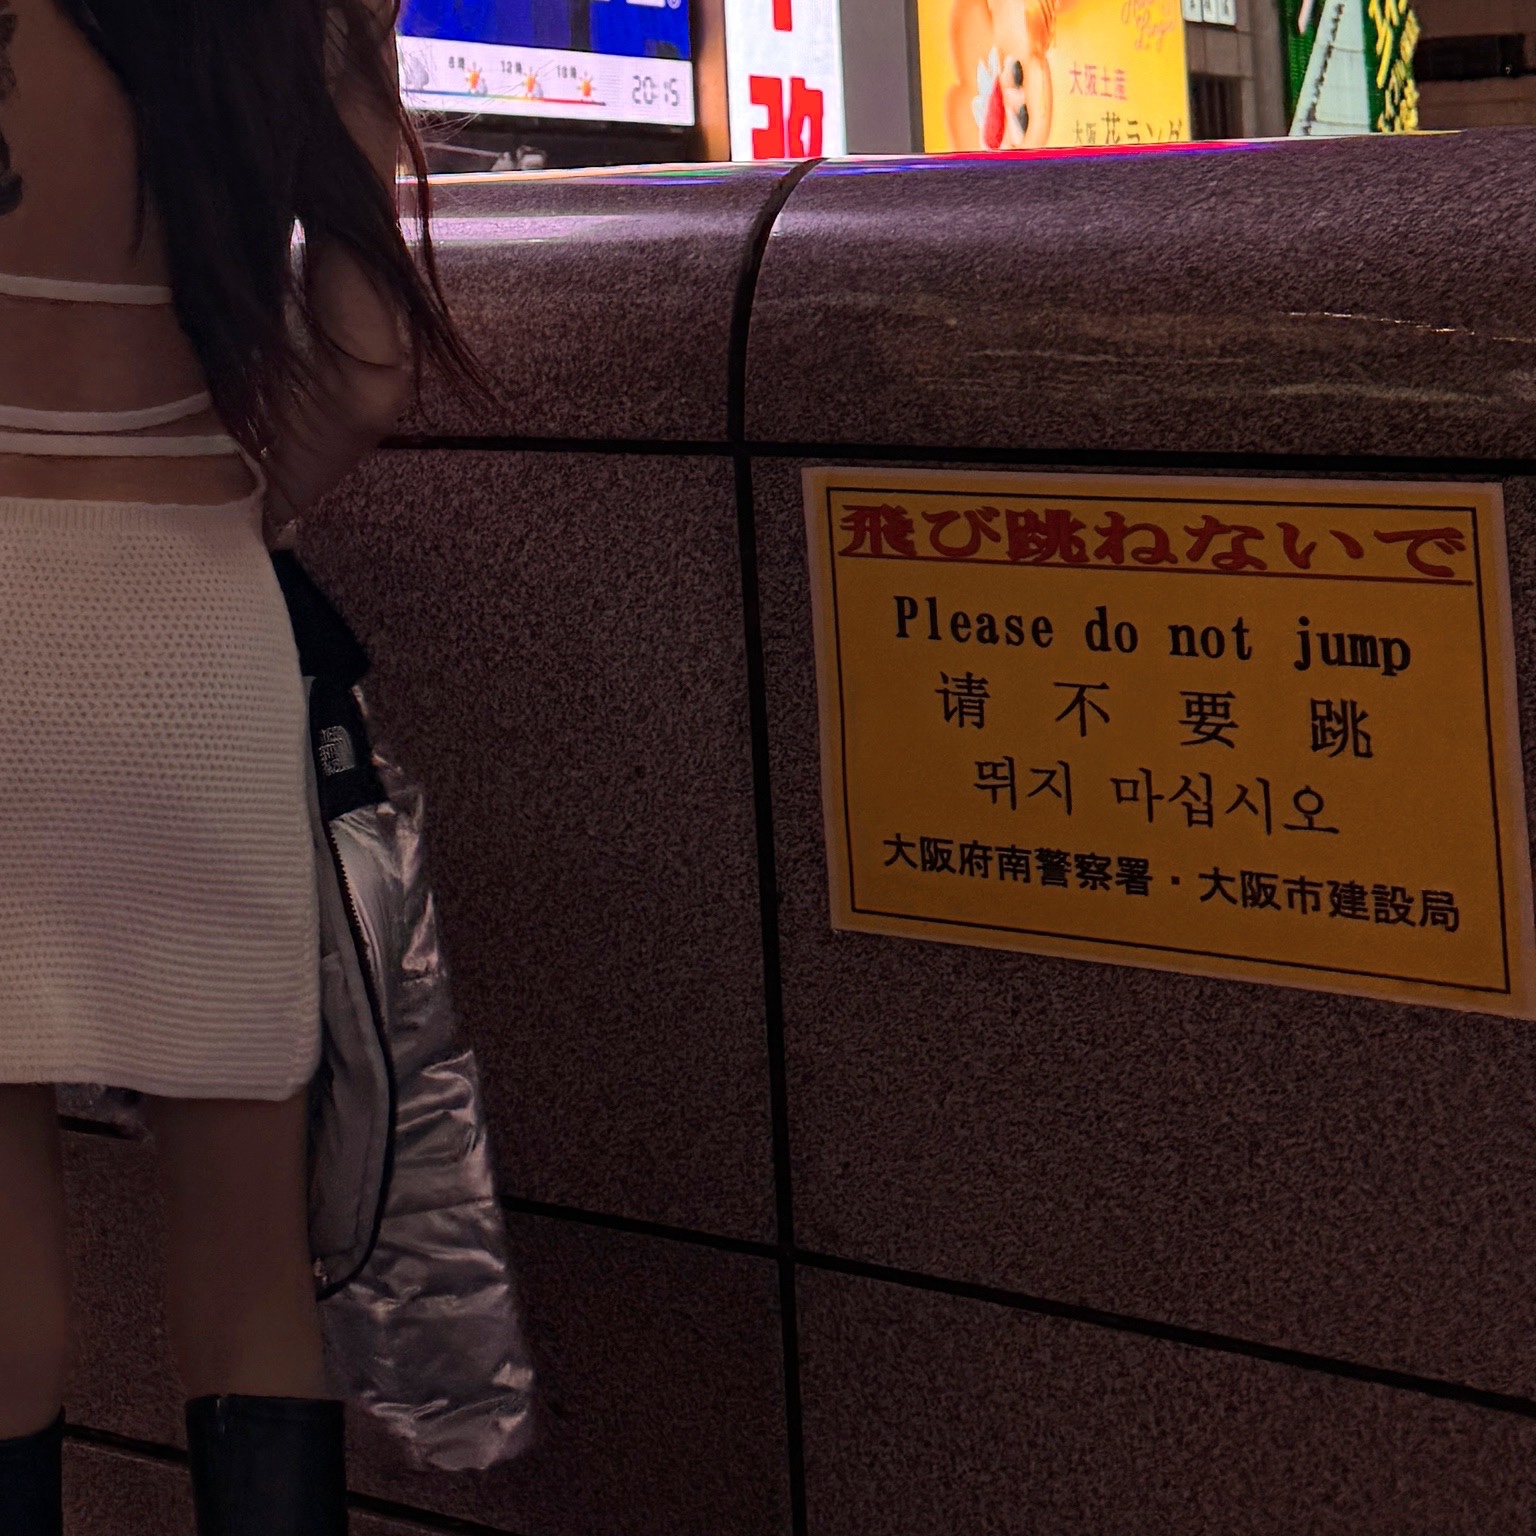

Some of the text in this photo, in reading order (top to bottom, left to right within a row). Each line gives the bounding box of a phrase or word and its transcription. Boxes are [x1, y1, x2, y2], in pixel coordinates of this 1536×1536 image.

[838, 502, 1467, 579] 飛び跳ねないで
[893, 595, 1413, 677] Please do not jump
[972, 755, 1341, 836] 뛰지 마십시오
